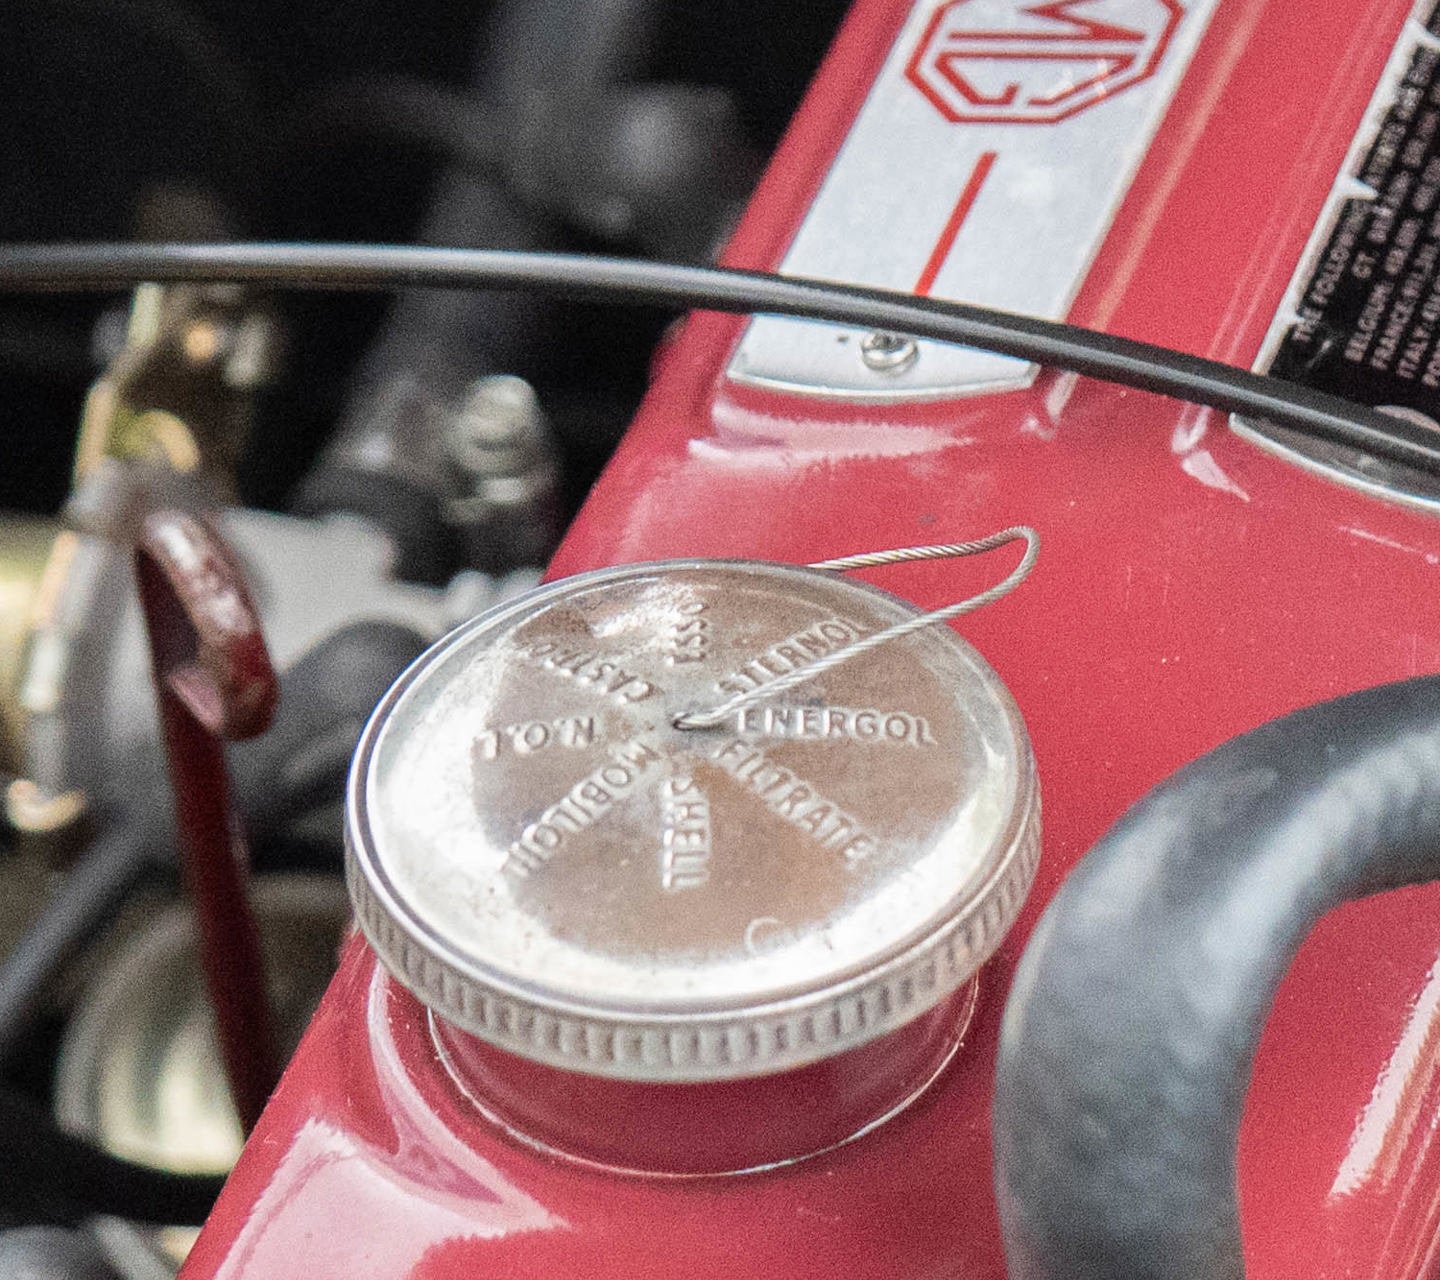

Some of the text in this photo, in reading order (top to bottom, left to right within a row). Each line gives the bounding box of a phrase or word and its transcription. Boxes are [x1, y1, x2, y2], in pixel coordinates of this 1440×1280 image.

[735, 704, 937, 747] ENERGOL
[499, 738, 661, 878] MOBILOIL
[661, 772, 711, 894] SHELL
[712, 737, 874, 868] FILTRATE
